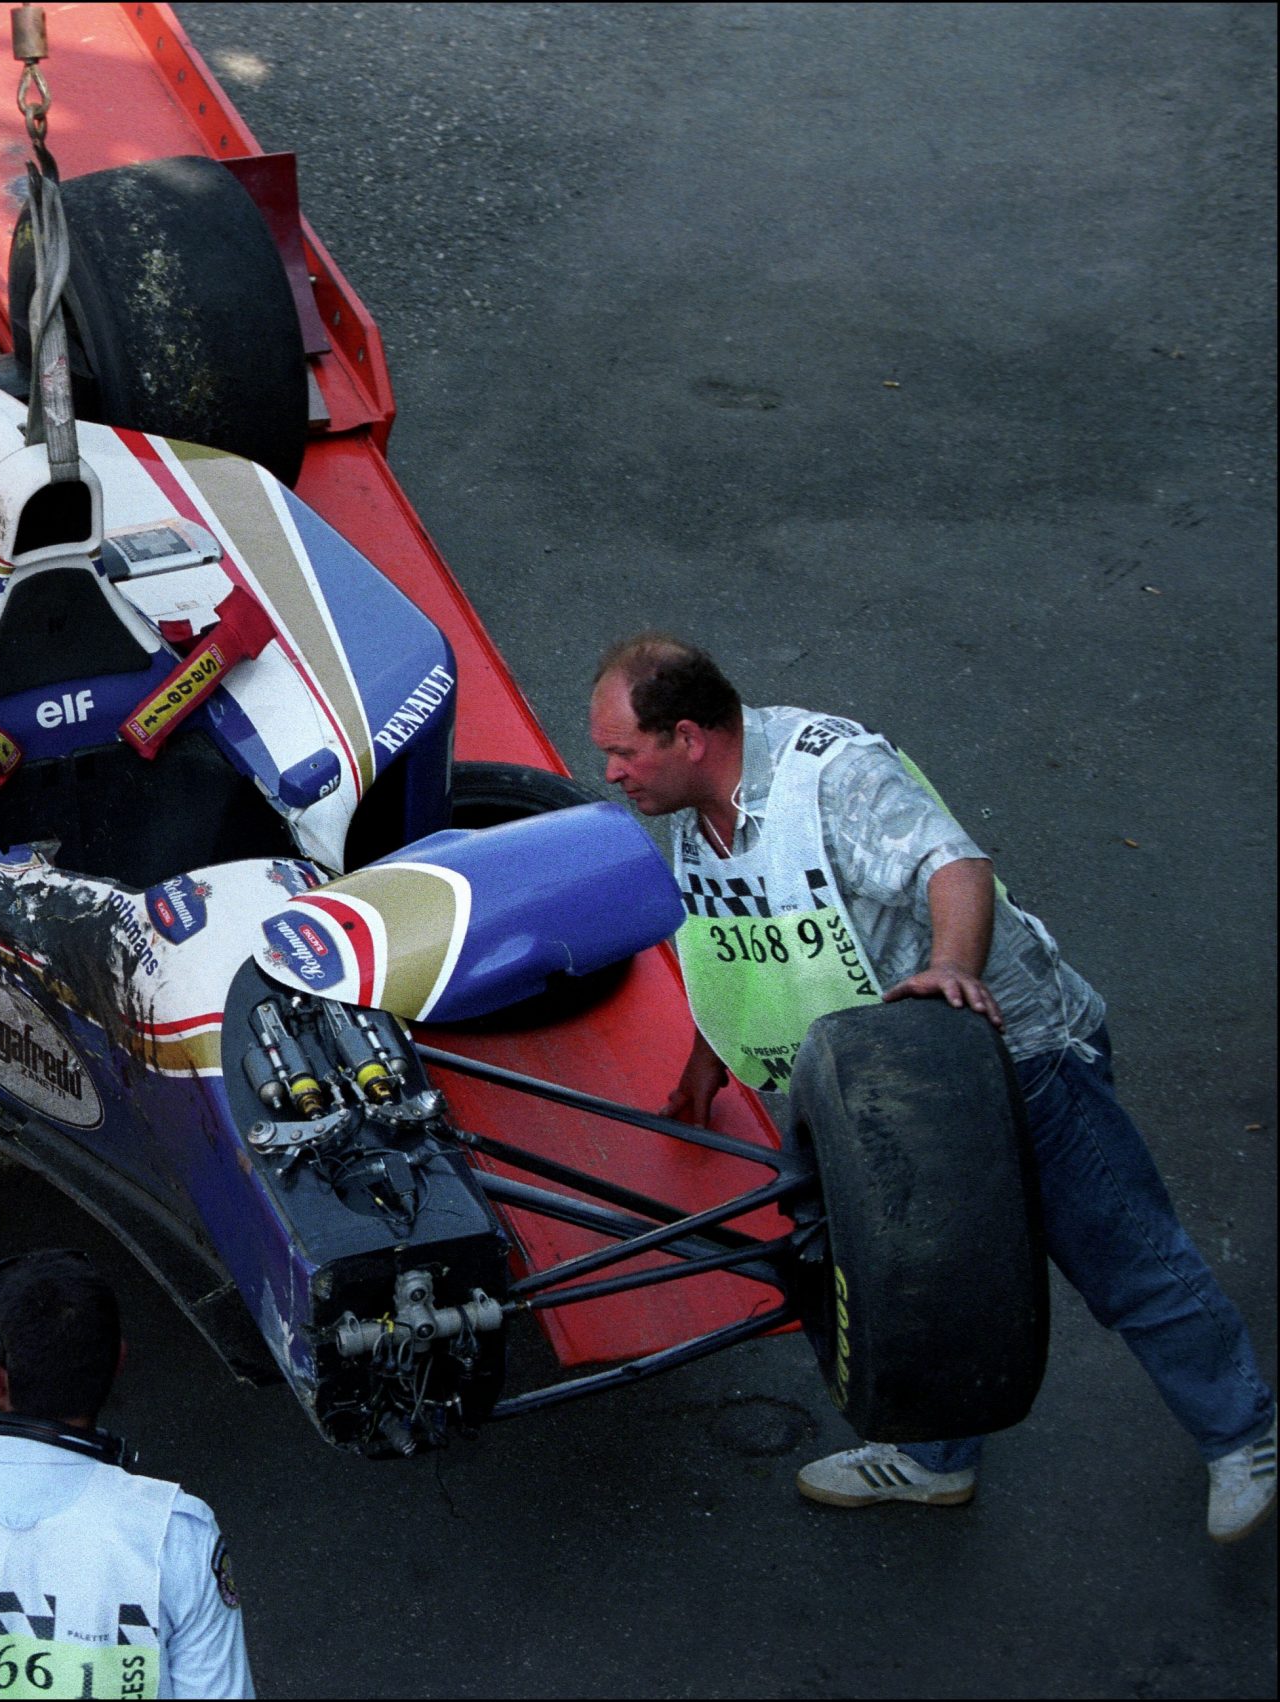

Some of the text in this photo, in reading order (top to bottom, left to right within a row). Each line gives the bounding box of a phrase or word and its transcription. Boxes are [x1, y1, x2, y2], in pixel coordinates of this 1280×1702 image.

[36, 689, 95, 729] elf
[144, 658, 218, 728] Sabelt
[373, 664, 455, 754] RENAULT
[109, 891, 159, 976] othmans
[826, 914, 878, 996] ACCESS
[21, 1066, 67, 1101] ZANETTI
[753, 1045, 790, 1057] PREMIO
